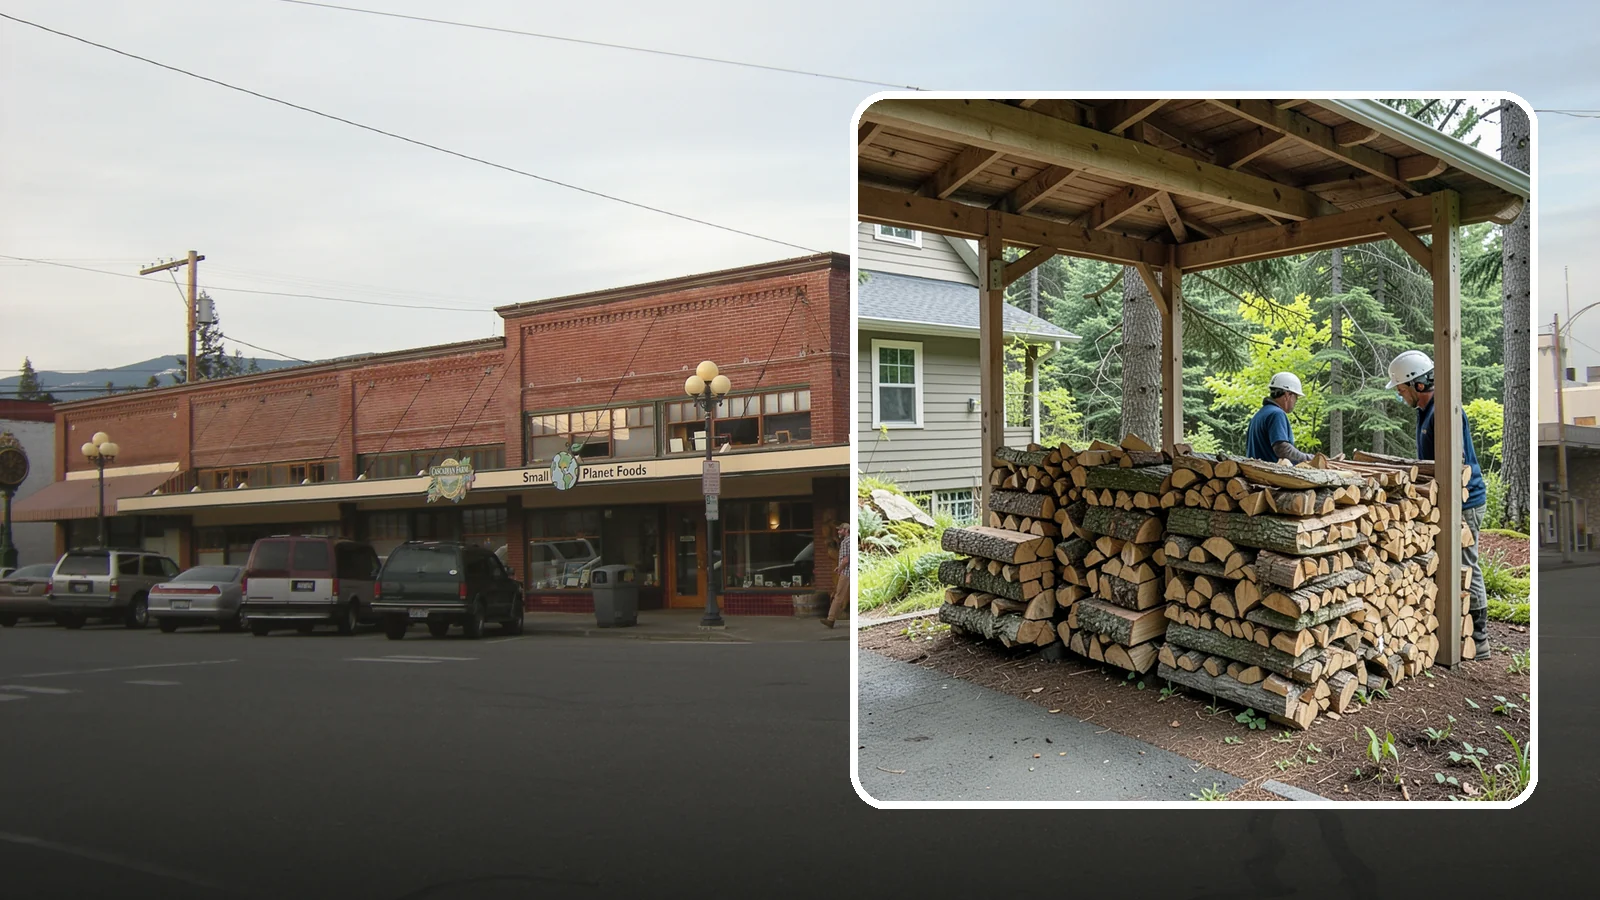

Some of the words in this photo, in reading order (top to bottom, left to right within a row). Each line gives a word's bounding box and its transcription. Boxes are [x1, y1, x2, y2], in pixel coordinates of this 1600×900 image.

[523, 471, 549, 482] Small
[583, 468, 614, 479] Planet
[617, 464, 647, 477] Foods
